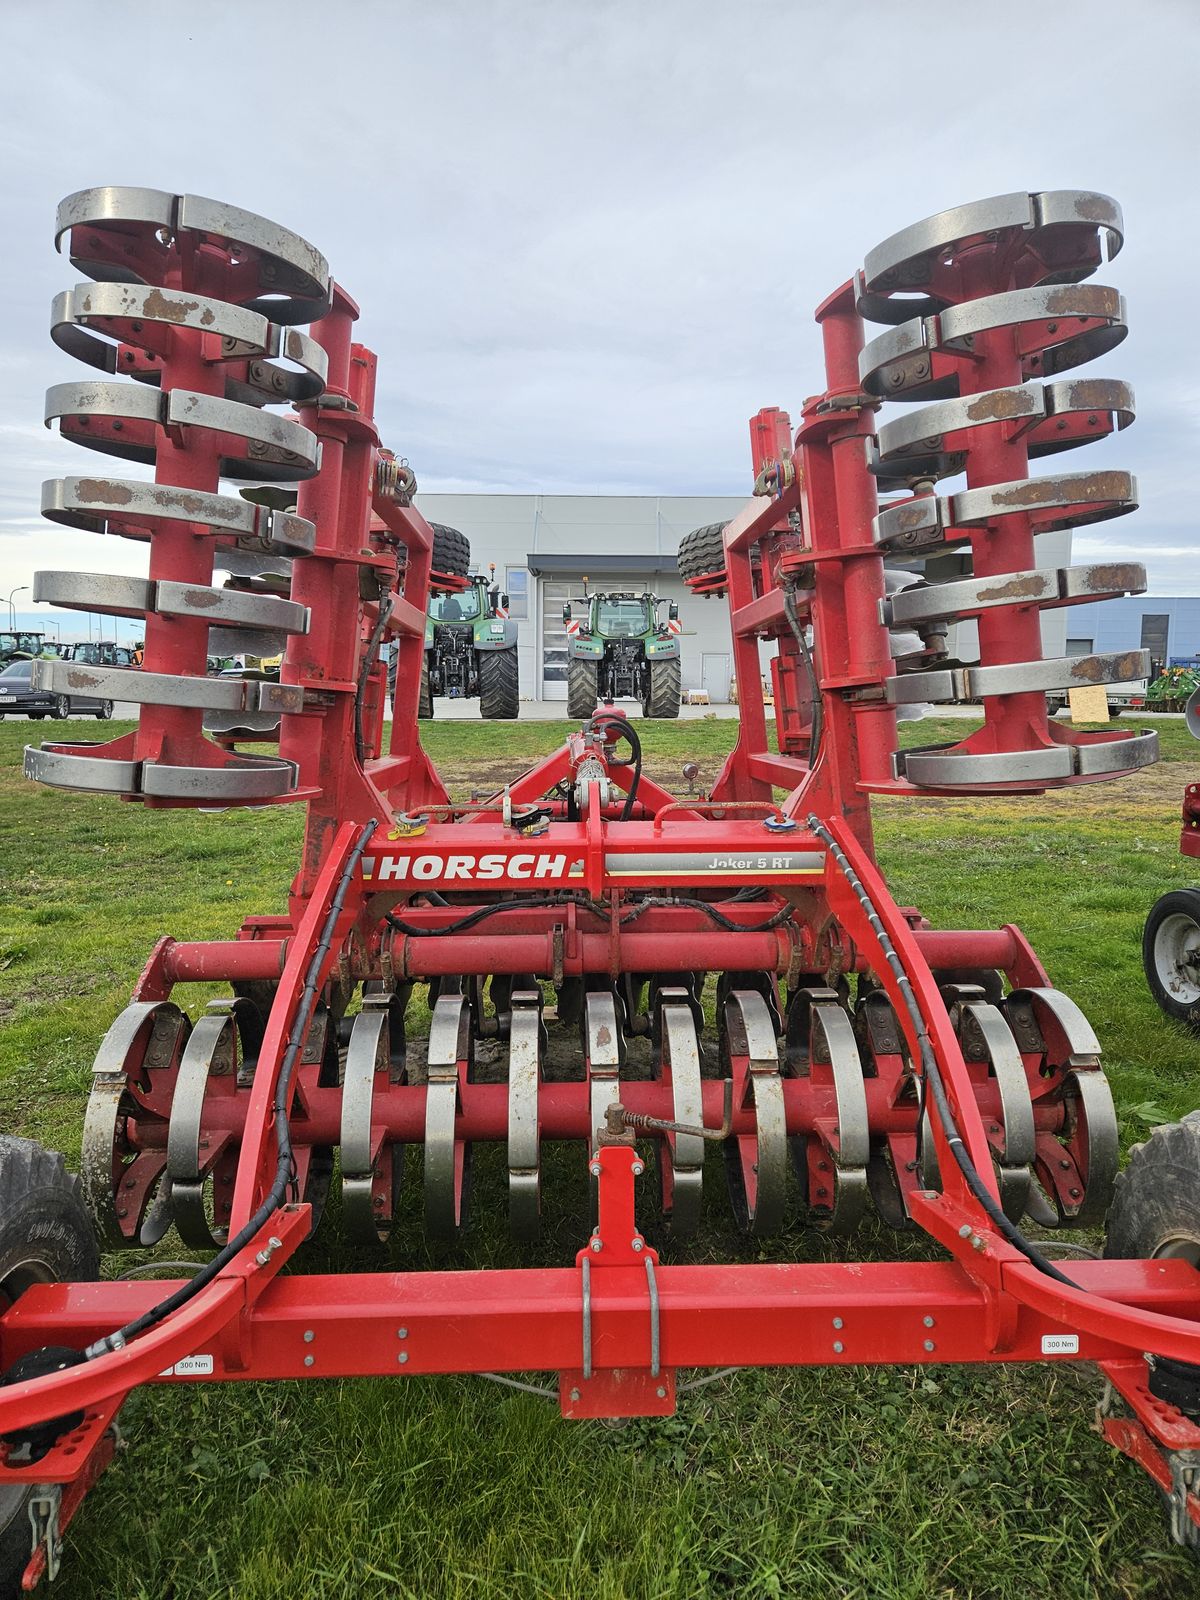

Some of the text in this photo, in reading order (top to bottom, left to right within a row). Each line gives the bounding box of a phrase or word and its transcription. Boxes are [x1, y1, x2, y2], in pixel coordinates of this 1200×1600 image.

[378, 854, 567, 880] HORSCH
[708, 857, 793, 869] Joker 5 RT
[180, 1361, 194, 1369] 300
